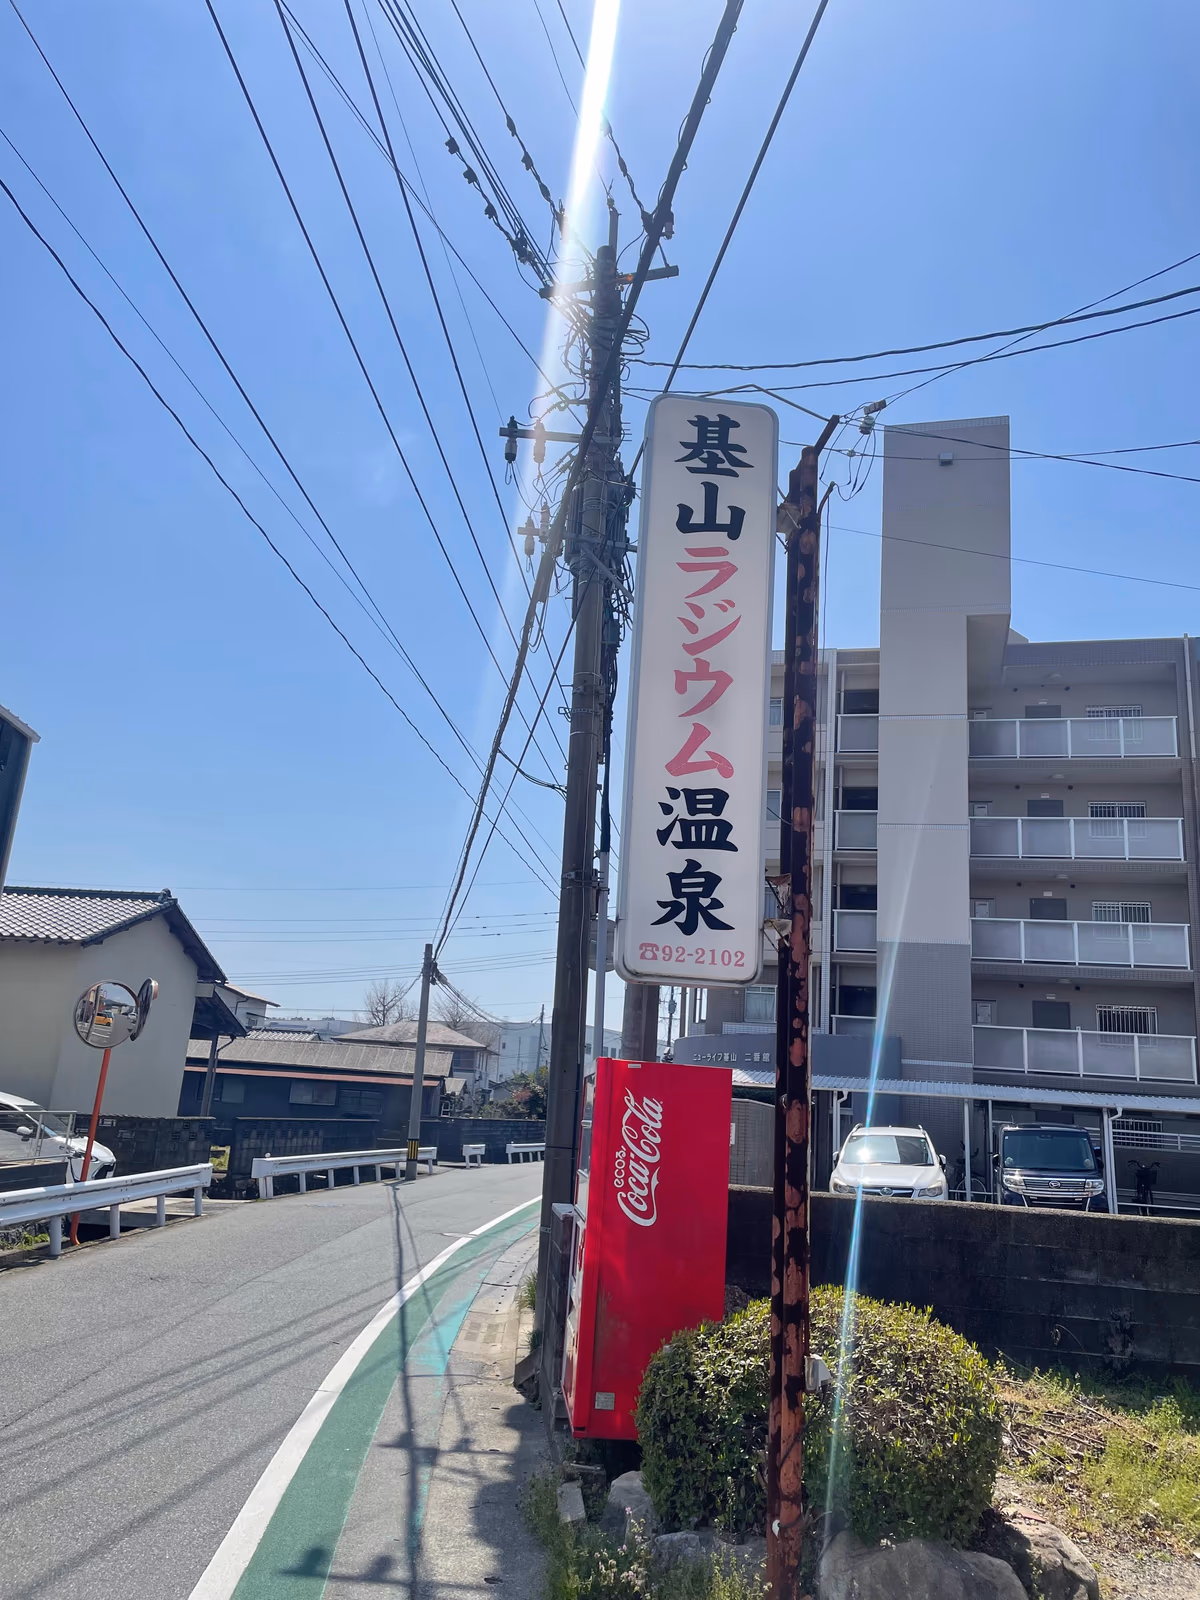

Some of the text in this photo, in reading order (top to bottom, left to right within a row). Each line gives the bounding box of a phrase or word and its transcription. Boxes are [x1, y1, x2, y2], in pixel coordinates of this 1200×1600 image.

[650, 414, 754, 936] 基山ラジウム温泉
[661, 945, 745, 967] 92-2102
[617, 1087, 663, 1227] Coca-Cola
